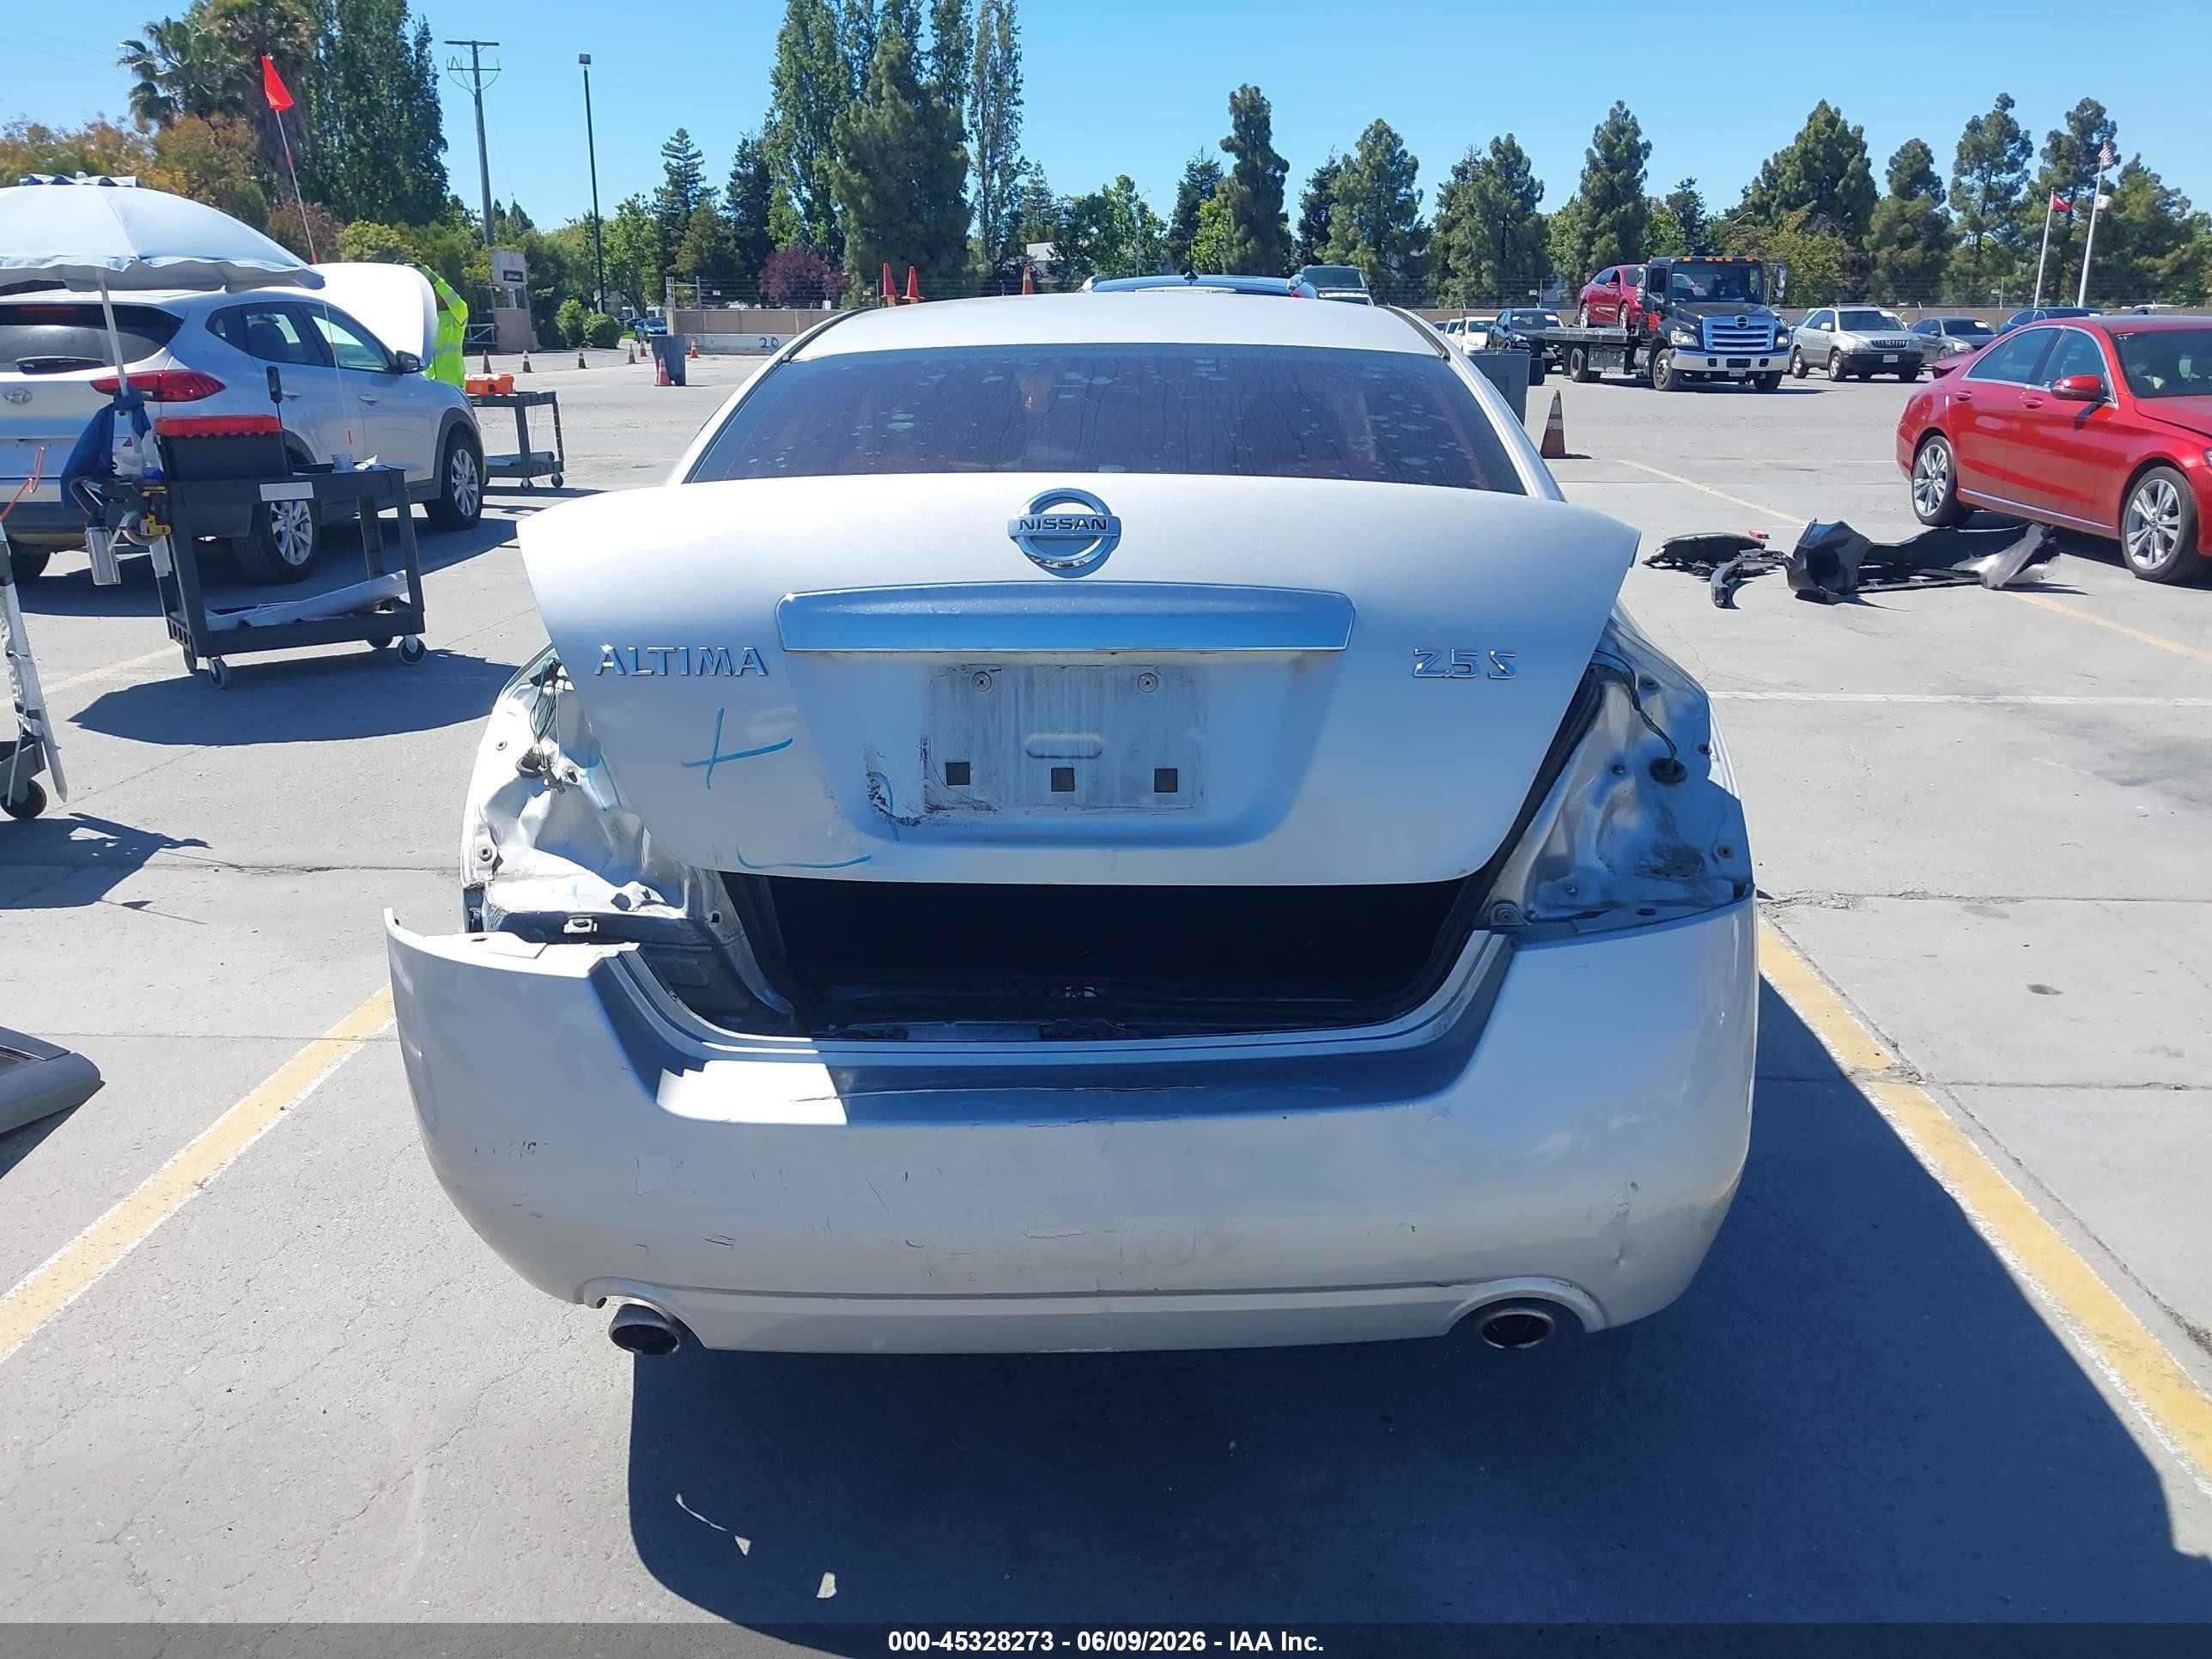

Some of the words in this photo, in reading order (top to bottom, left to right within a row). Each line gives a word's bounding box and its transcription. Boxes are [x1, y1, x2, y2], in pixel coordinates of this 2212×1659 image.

[758, 337, 780, 349] 20
[1019, 518, 1109, 532] NISSAN
[593, 644, 768, 677] ALTIMA
[1488, 649, 1517, 679] S
